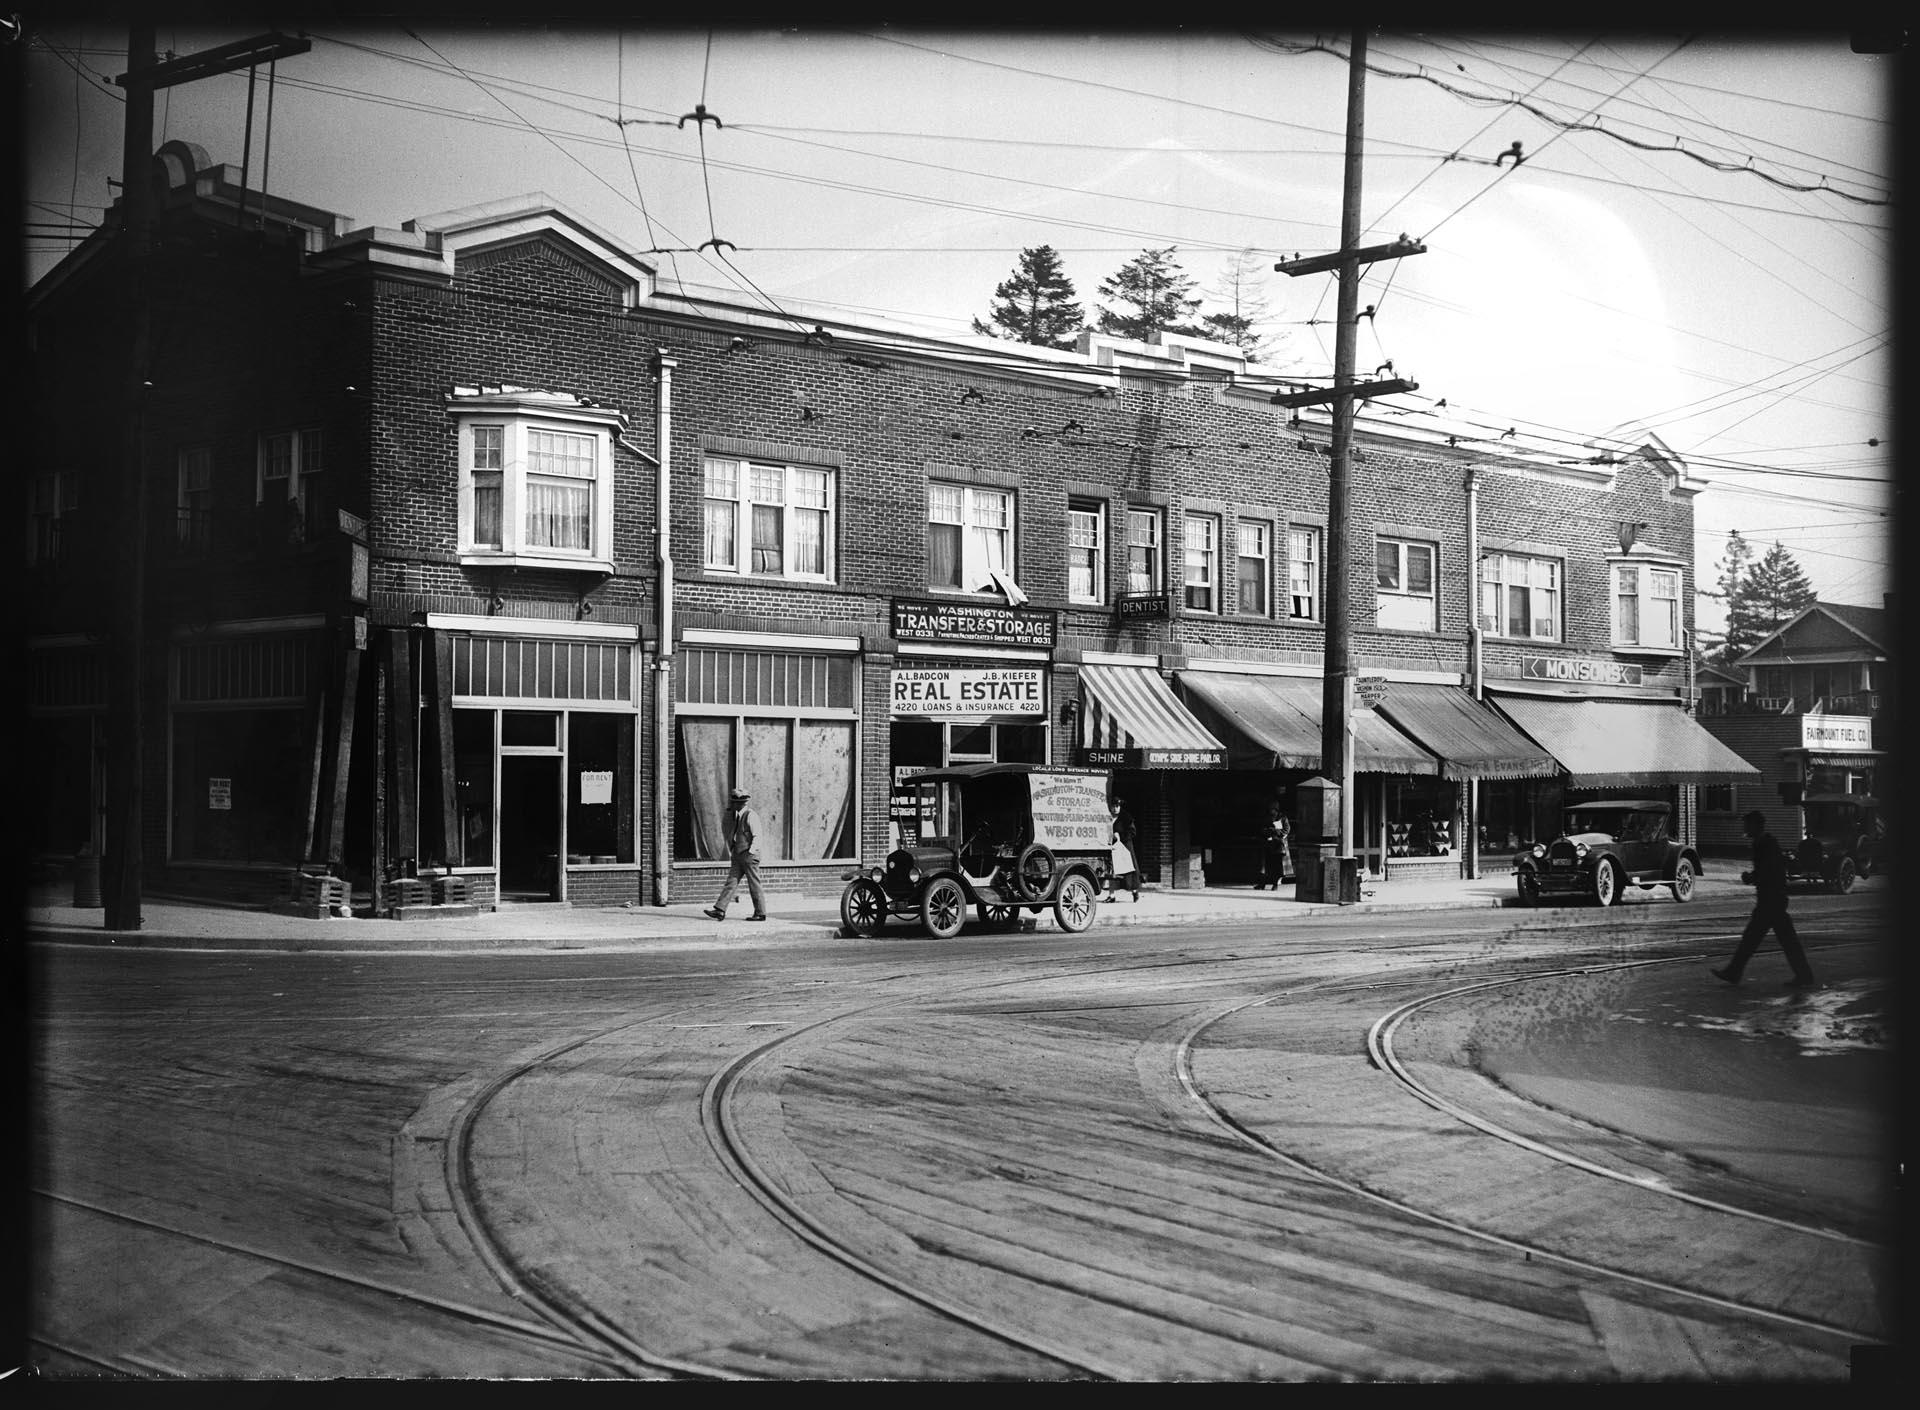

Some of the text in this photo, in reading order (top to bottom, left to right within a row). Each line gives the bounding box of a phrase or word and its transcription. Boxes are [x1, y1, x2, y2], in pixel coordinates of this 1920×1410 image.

[937, 606, 1014, 618] WASHINGTON
[896, 629, 935, 637] WEST 0331
[994, 634, 1015, 642] SHIPPED
[1016, 636, 1031, 644] WEST
[1002, 672, 1037, 680] KIEFER
[894, 682, 1038, 700] REAL ESTATE
[895, 702, 1040, 712] 4220 LOANS & INSURANCE 4220
[1806, 727, 1839, 741] FAIRMOUNT
[1841, 728, 1856, 742] FUEL
[1088, 752, 1125, 763] SHINE
[1183, 753, 1200, 763] SHINE
[1200, 753, 1221, 764] PARLOR
[1046, 796, 1092, 807] & STORAGE
[1044, 825, 1098, 838] WEST 0331
